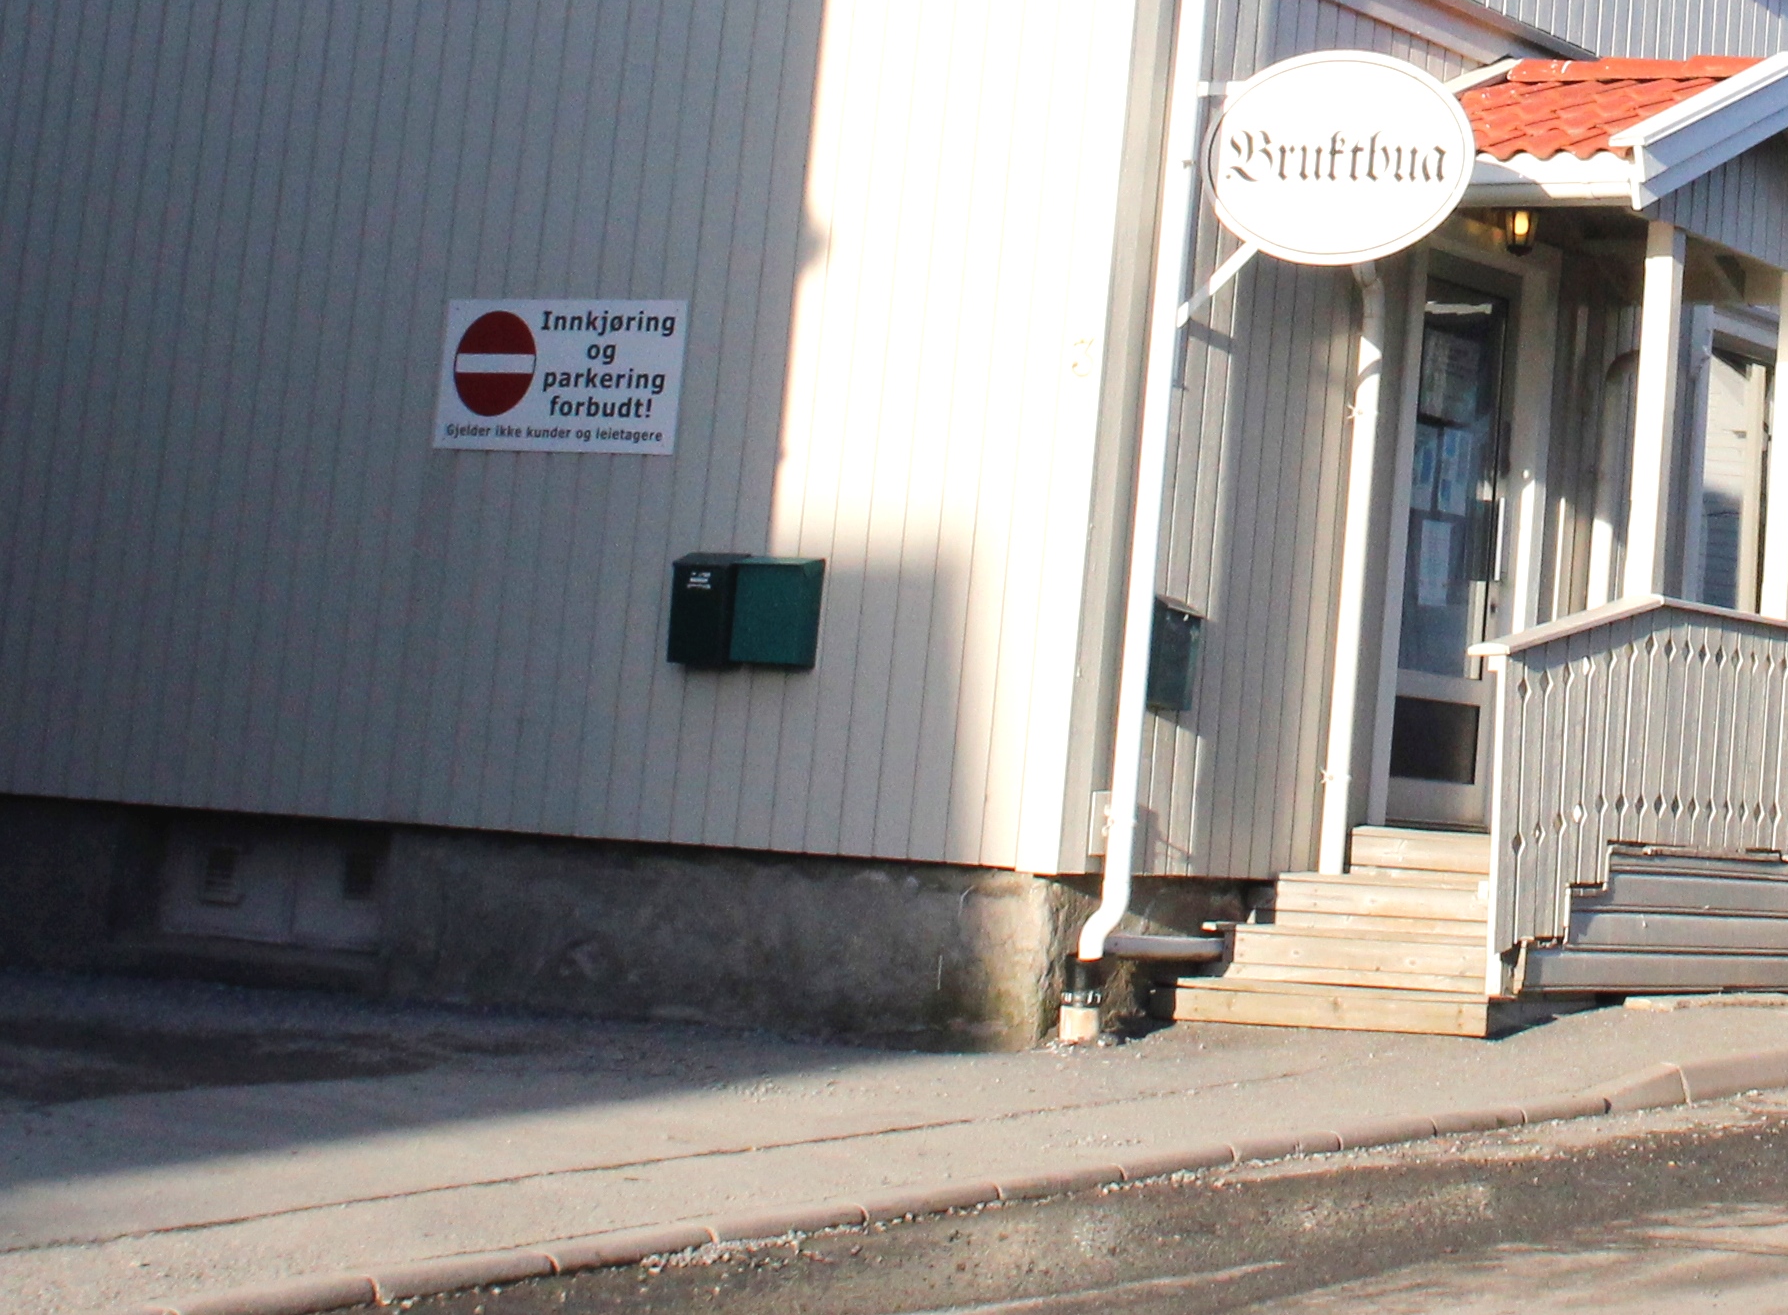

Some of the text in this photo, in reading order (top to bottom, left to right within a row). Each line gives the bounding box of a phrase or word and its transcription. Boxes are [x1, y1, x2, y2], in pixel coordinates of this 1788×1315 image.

[1225, 130, 1447, 183] Bruktbua
[540, 310, 676, 337] Innkjøring
[586, 343, 616, 365] og
[542, 368, 666, 395] parkering
[549, 395, 653, 419] forbudt!
[446, 423, 663, 443] Gjelder ikke kunder og leietagere
